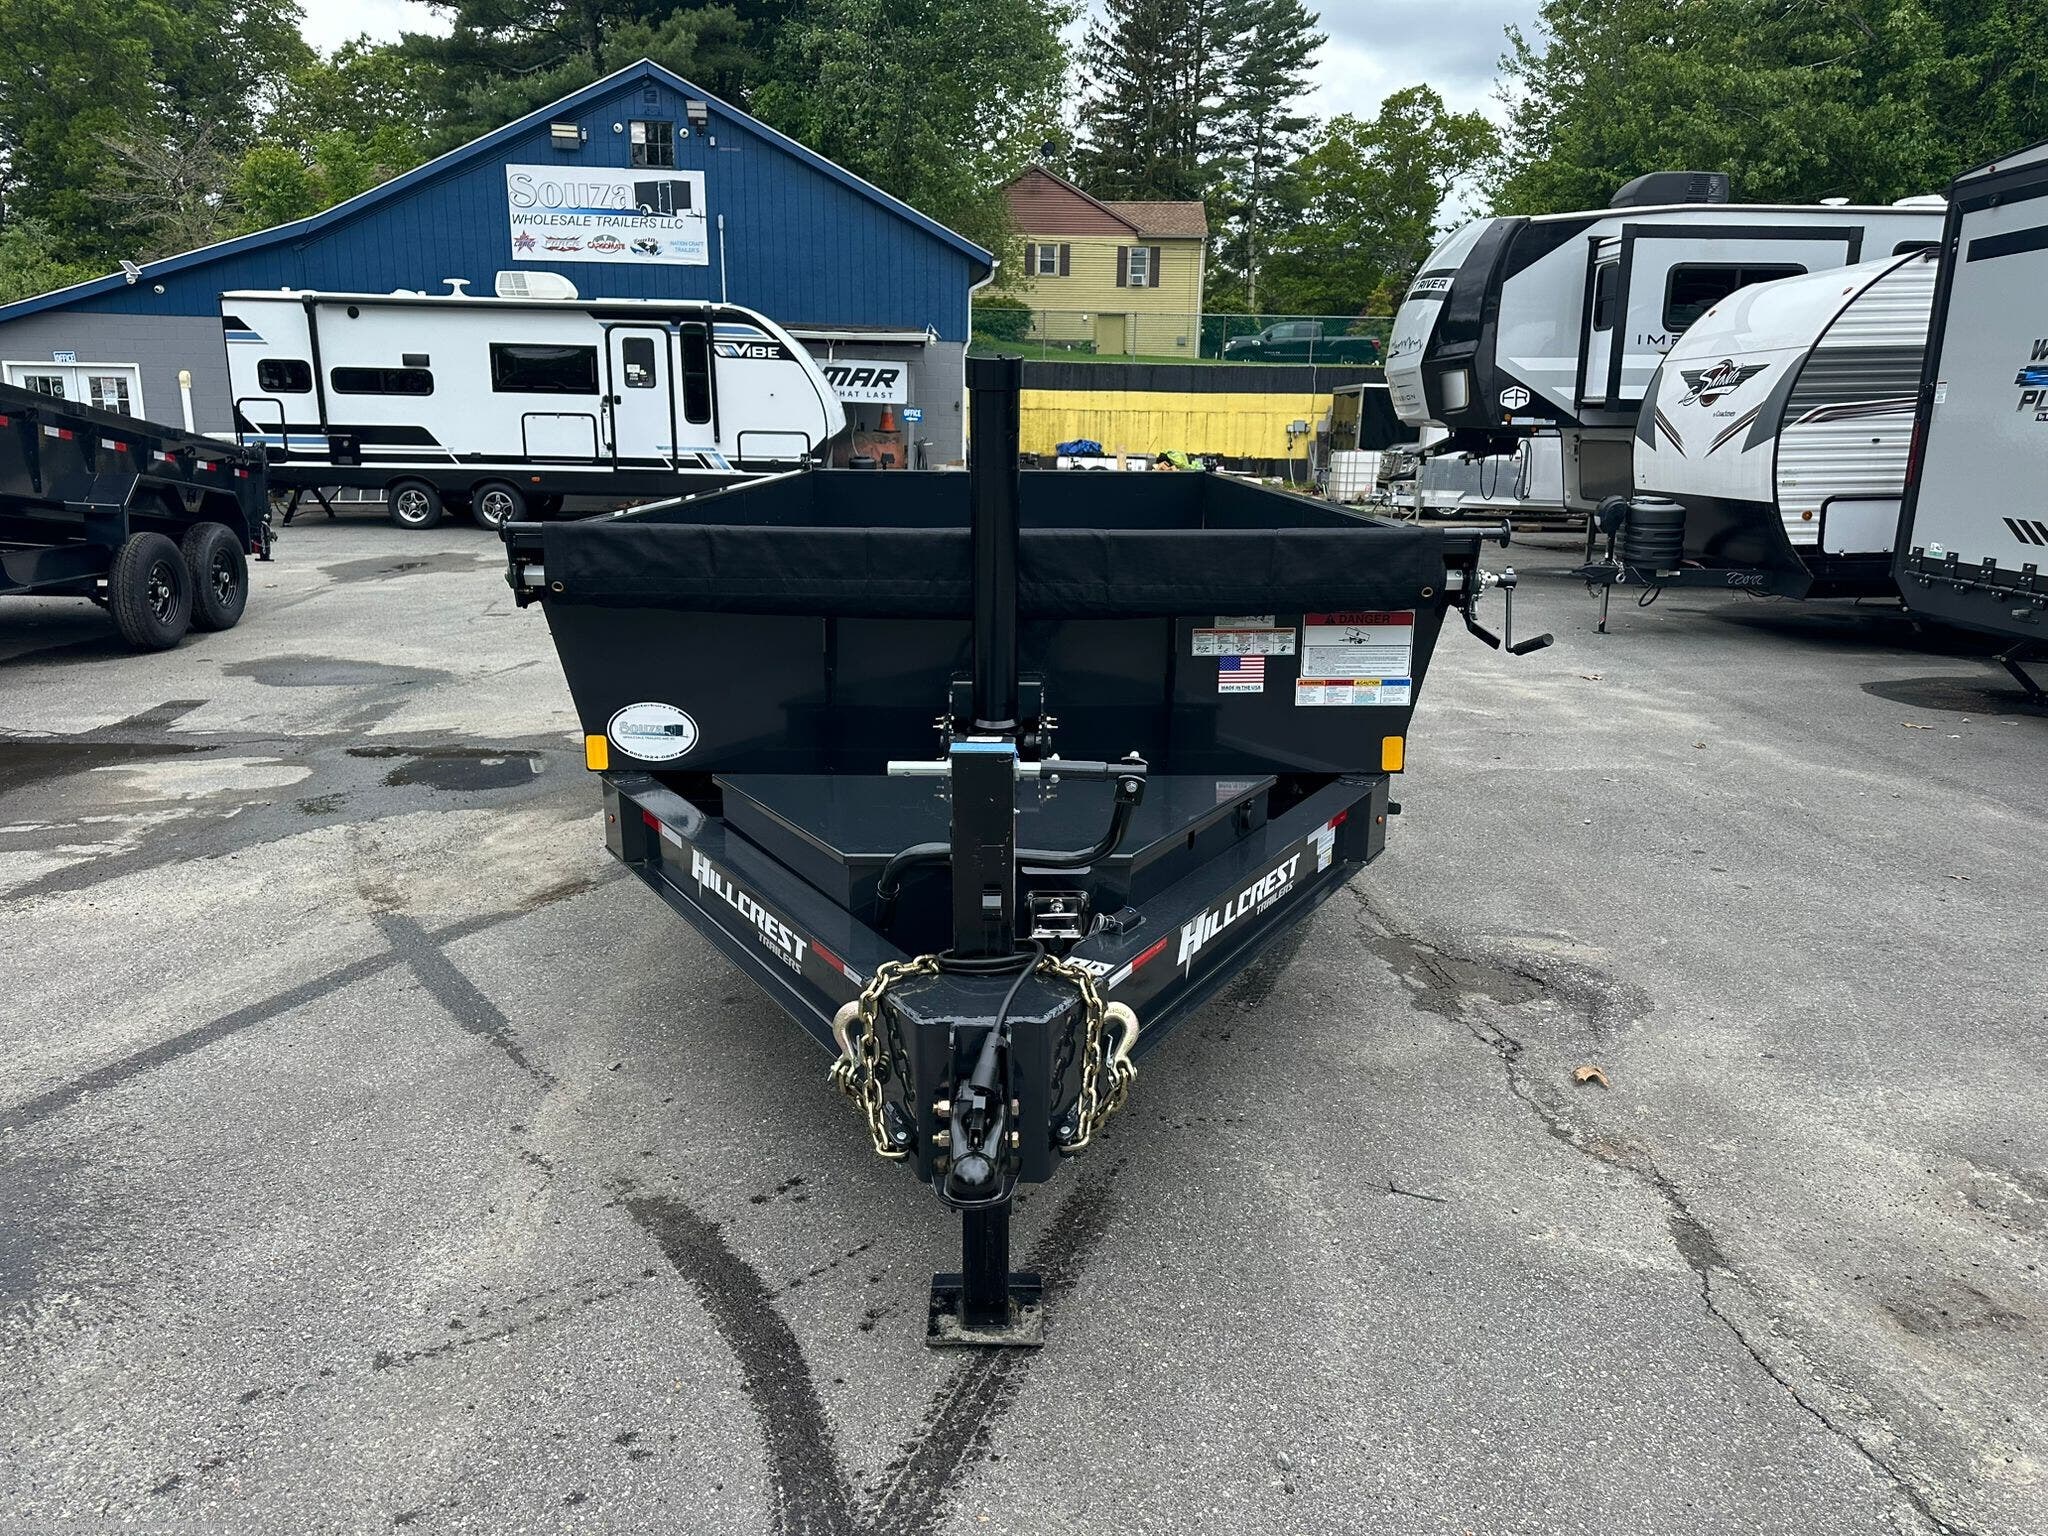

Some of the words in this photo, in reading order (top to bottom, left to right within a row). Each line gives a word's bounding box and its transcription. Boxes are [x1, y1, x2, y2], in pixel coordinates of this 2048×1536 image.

[509, 173, 634, 210] Souza
[512, 213, 591, 226] WHOLESALE
[596, 216, 657, 228] TRAILERS
[660, 218, 684, 229] LLC
[1418, 279, 1447, 290] RIVER
[728, 342, 780, 359] VIBE
[822, 366, 900, 388] MAR
[866, 391, 893, 399] LAST
[2016, 389, 2048, 411] PL
[903, 408, 921, 417] OFFICE
[1340, 614, 1391, 624] DANGER
[1256, 880, 1295, 916] TRAILERS
[758, 931, 802, 976] TRAILERS
